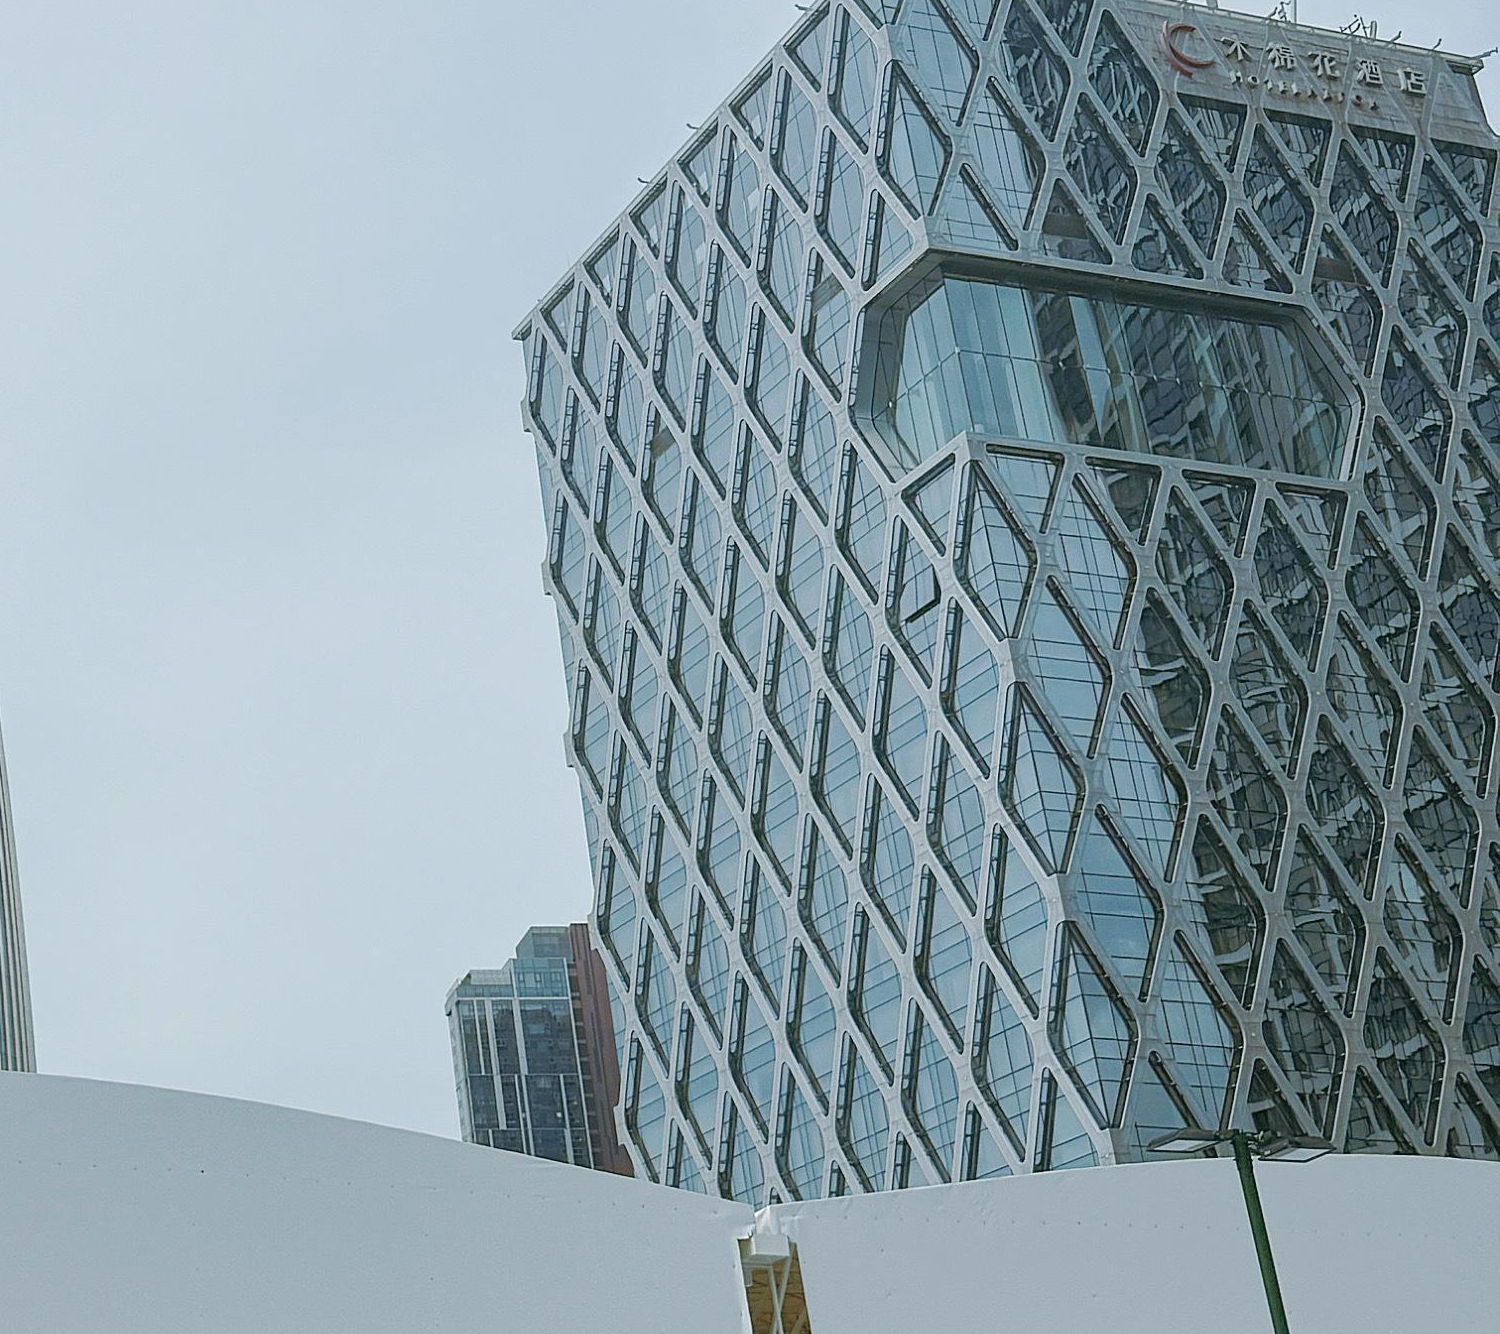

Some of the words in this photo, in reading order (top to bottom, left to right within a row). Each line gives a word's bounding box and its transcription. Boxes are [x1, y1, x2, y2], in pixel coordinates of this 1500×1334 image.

[1220, 34, 1427, 95] 木棉花酒店
